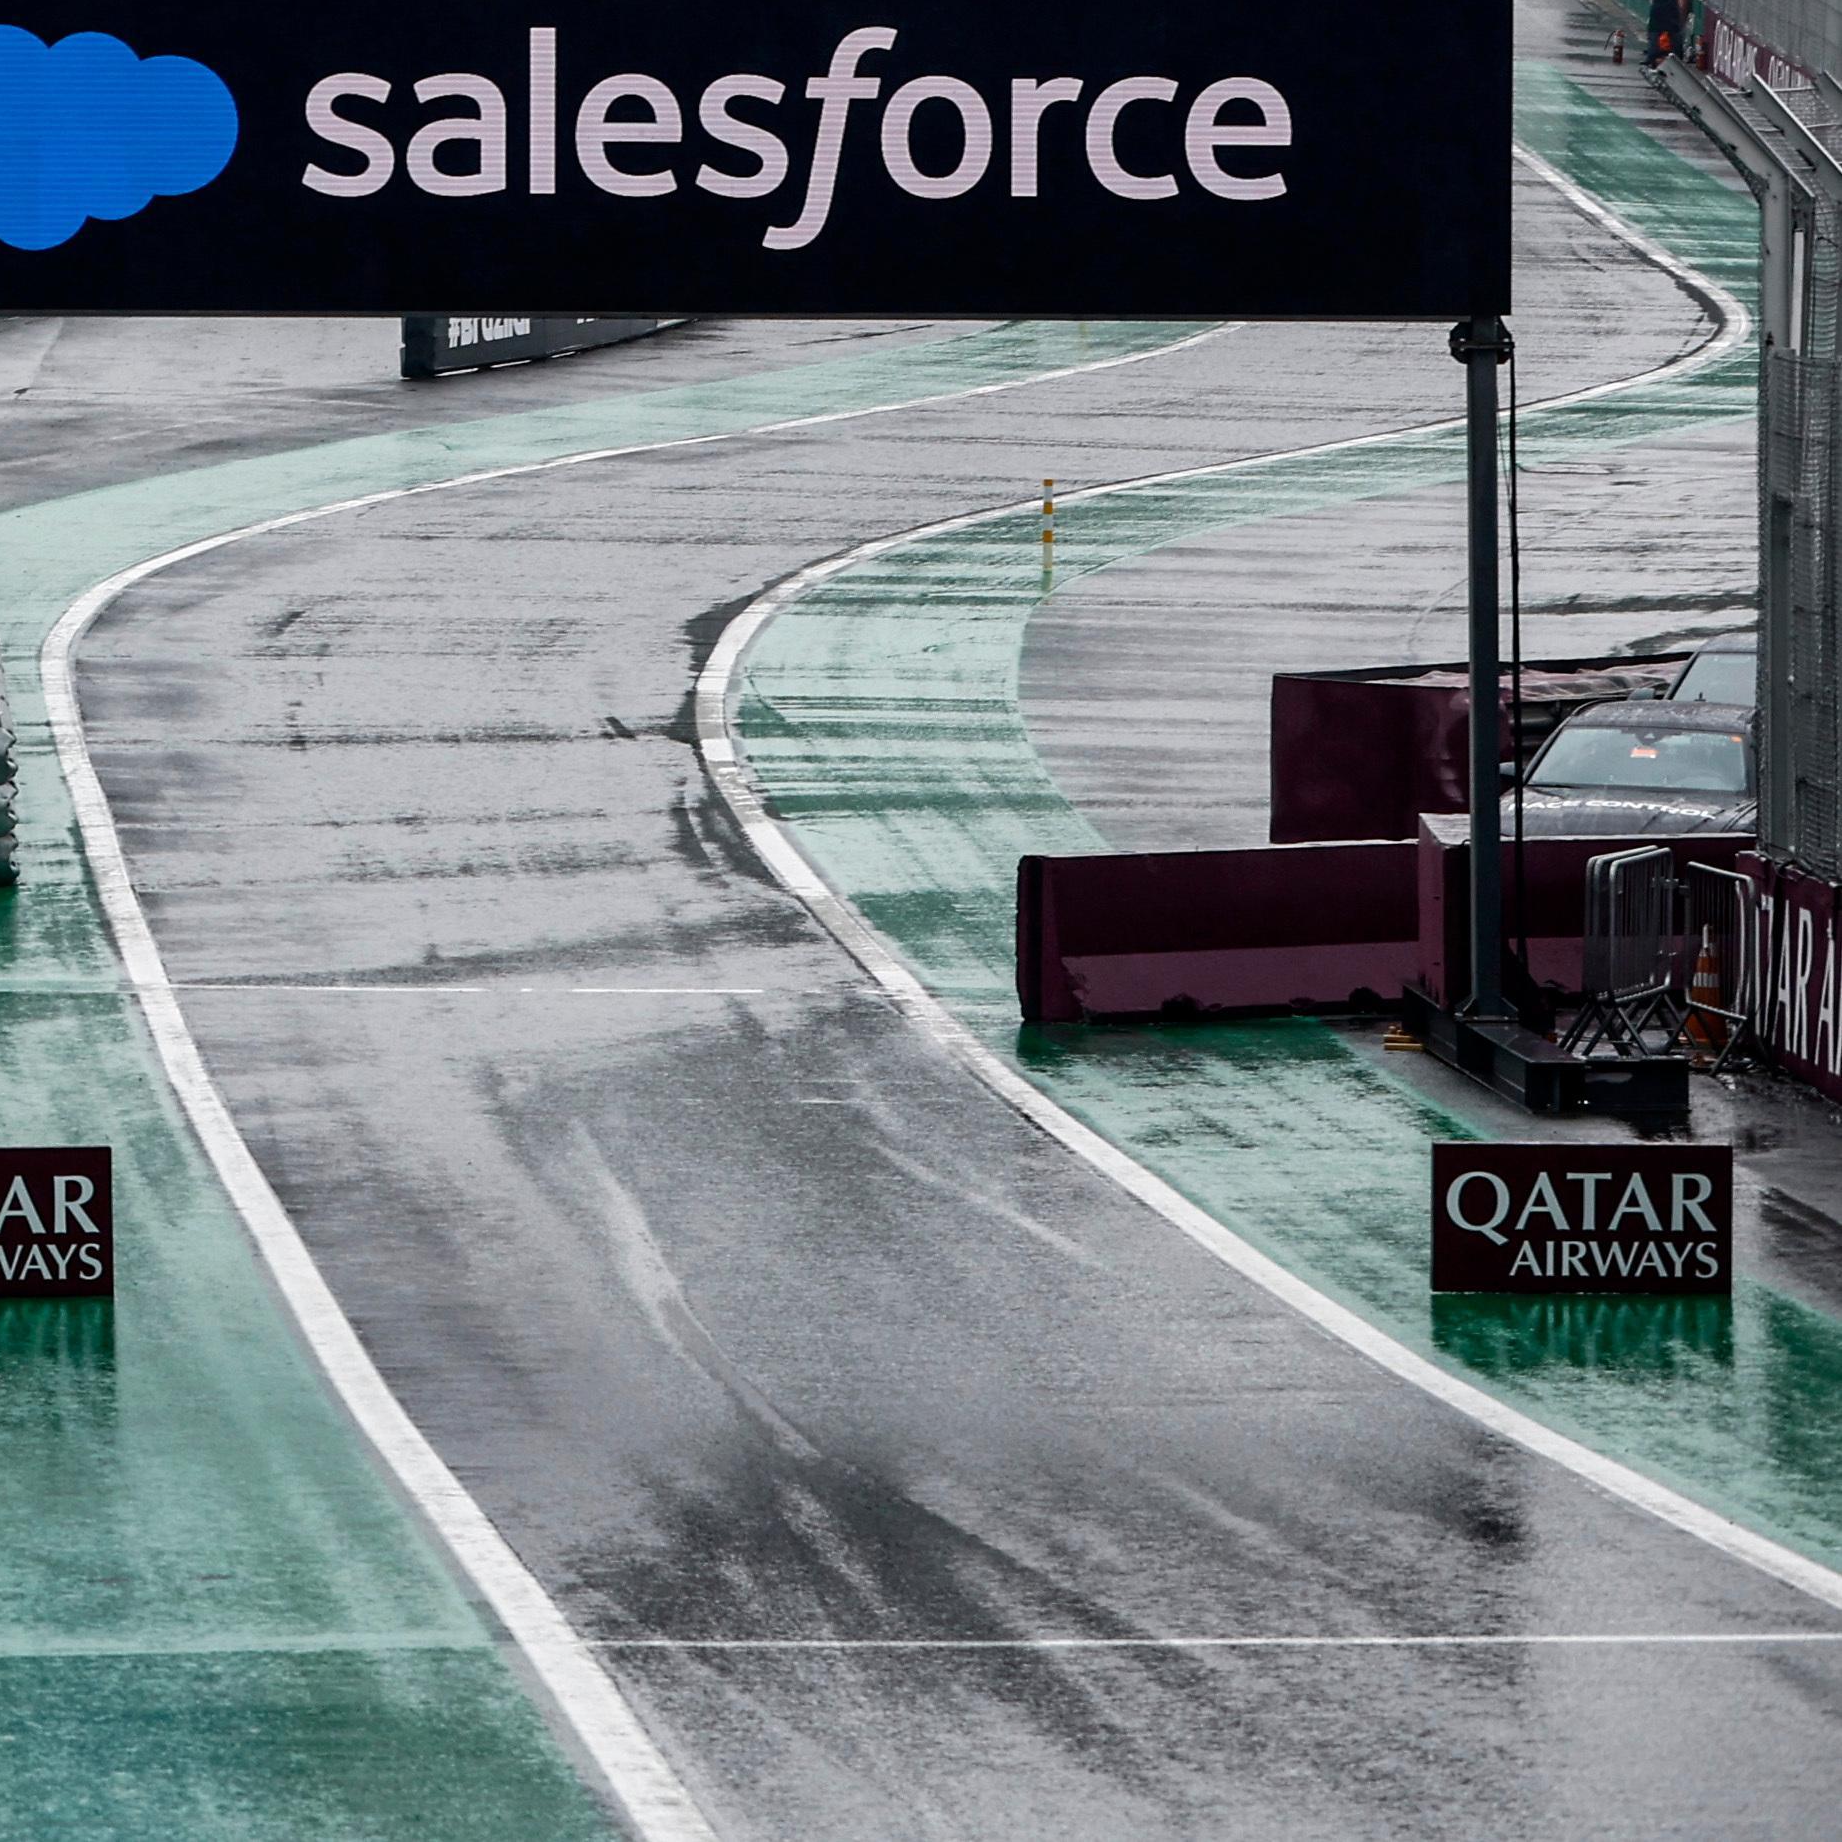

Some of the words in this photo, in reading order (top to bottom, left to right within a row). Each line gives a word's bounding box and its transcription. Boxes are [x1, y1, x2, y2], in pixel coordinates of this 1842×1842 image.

[300, 25, 1293, 252] salesforce
[1585, 800, 1716, 820] CONTROL
[1446, 1170, 1718, 1246] QATAR
[1509, 1241, 1720, 1279] AIRWAYS
